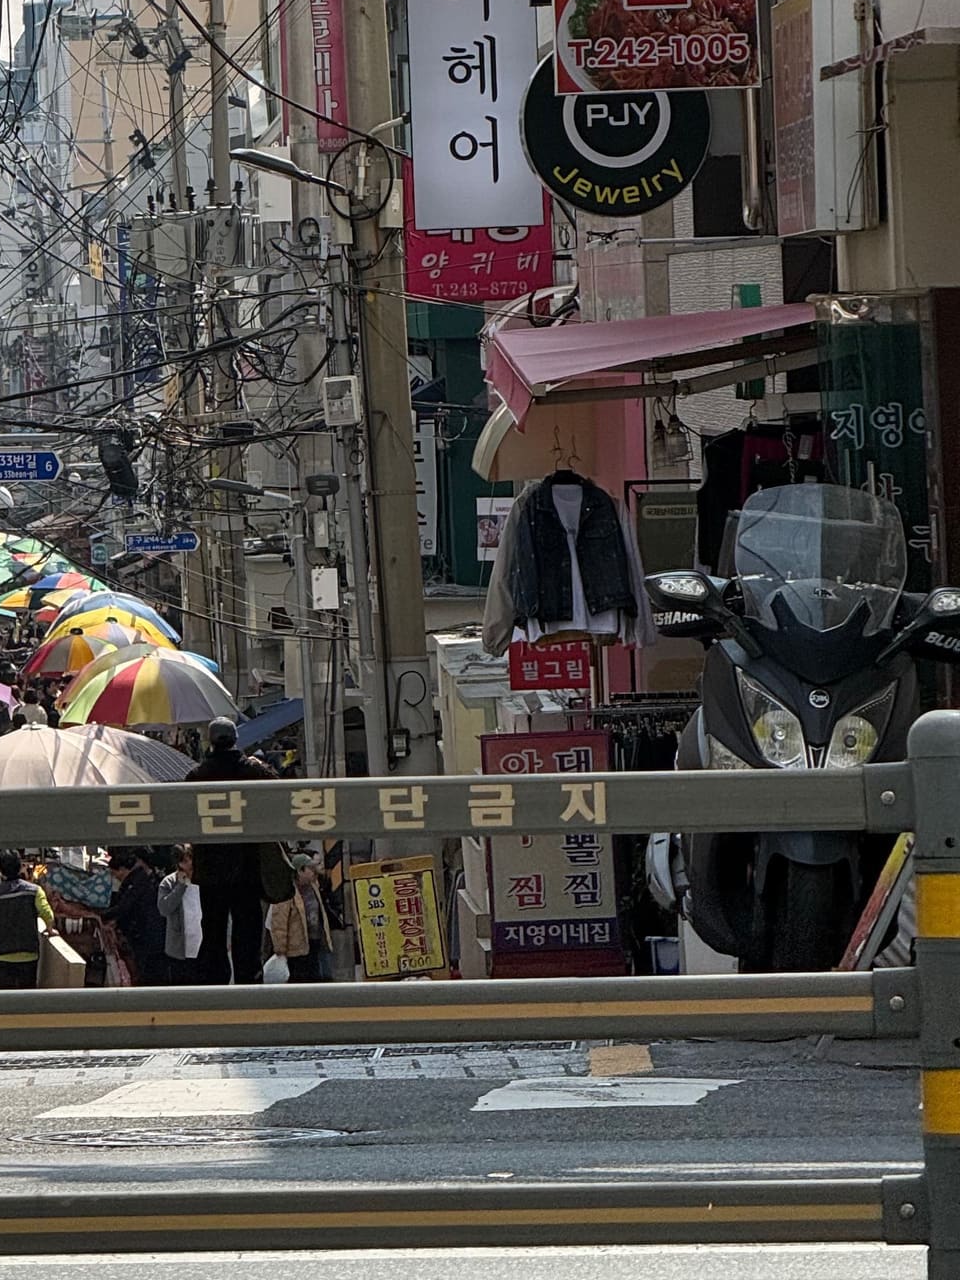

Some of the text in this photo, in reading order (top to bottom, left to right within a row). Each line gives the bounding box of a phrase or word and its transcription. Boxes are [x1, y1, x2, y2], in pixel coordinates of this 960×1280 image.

[568, 34, 750, 68] T.242-1005
[586, 102, 653, 127] PJY
[552, 158, 684, 204] Jewelry
[421, 250, 540, 279] 양귀비
[432, 281, 528, 297] T.243-8779
[45, 461, 53, 472] 6
[521, 660, 583, 680] 필그림
[368, 900, 385, 910] SBS
[504, 922, 611, 947] 지영이네집
